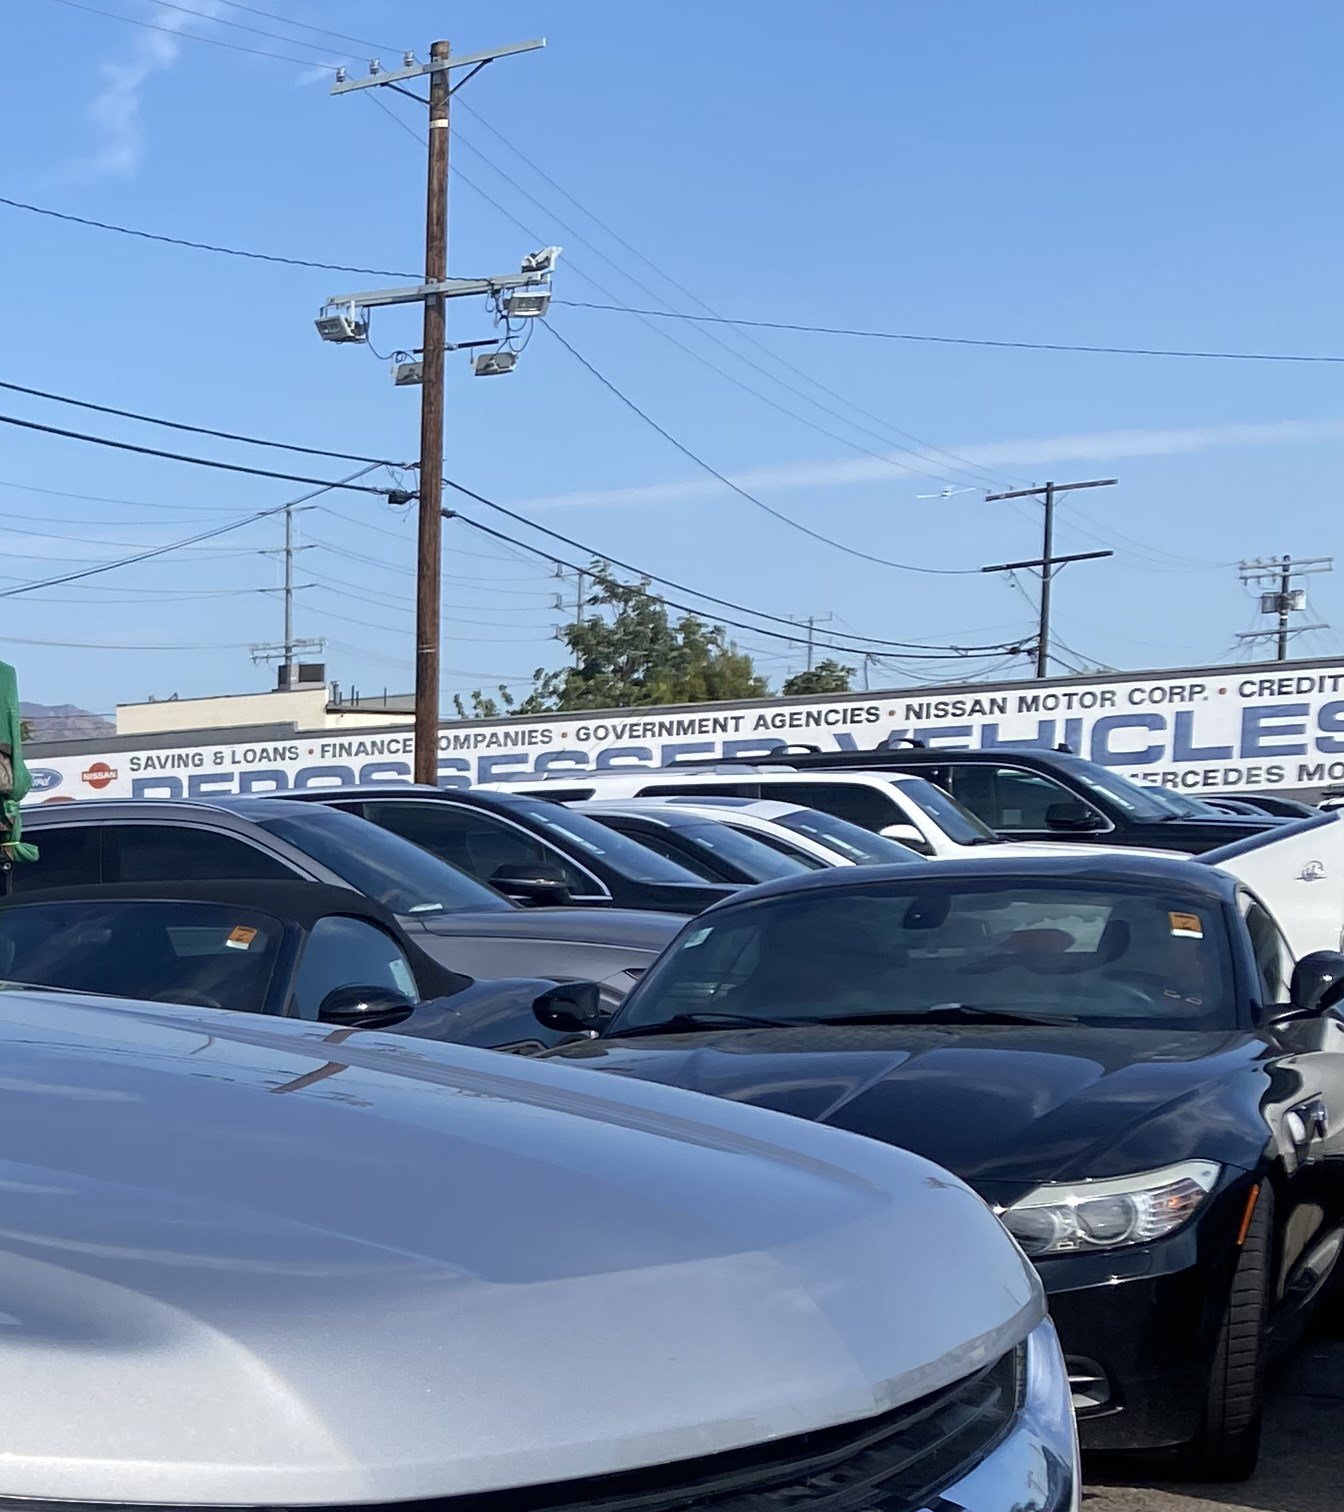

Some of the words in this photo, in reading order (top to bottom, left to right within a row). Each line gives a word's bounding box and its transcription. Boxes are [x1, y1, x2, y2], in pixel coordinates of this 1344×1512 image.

[129, 752, 204, 772] SAVING
[213, 750, 224, 766] &
[231, 746, 300, 765] LOANS
[320, 738, 414, 759] FINANCE
[437, 729, 553, 751] OMPANIES
[575, 715, 745, 742] GOVERNMENT
[754, 706, 881, 732] AGENCIES
[905, 697, 1008, 721] NISSAN
[1017, 690, 1117, 714] MOTOR
[1128, 684, 1209, 706] CORP.
[1238, 674, 1344, 699] CREDIT
[1129, 765, 1285, 789] ERCEDES
